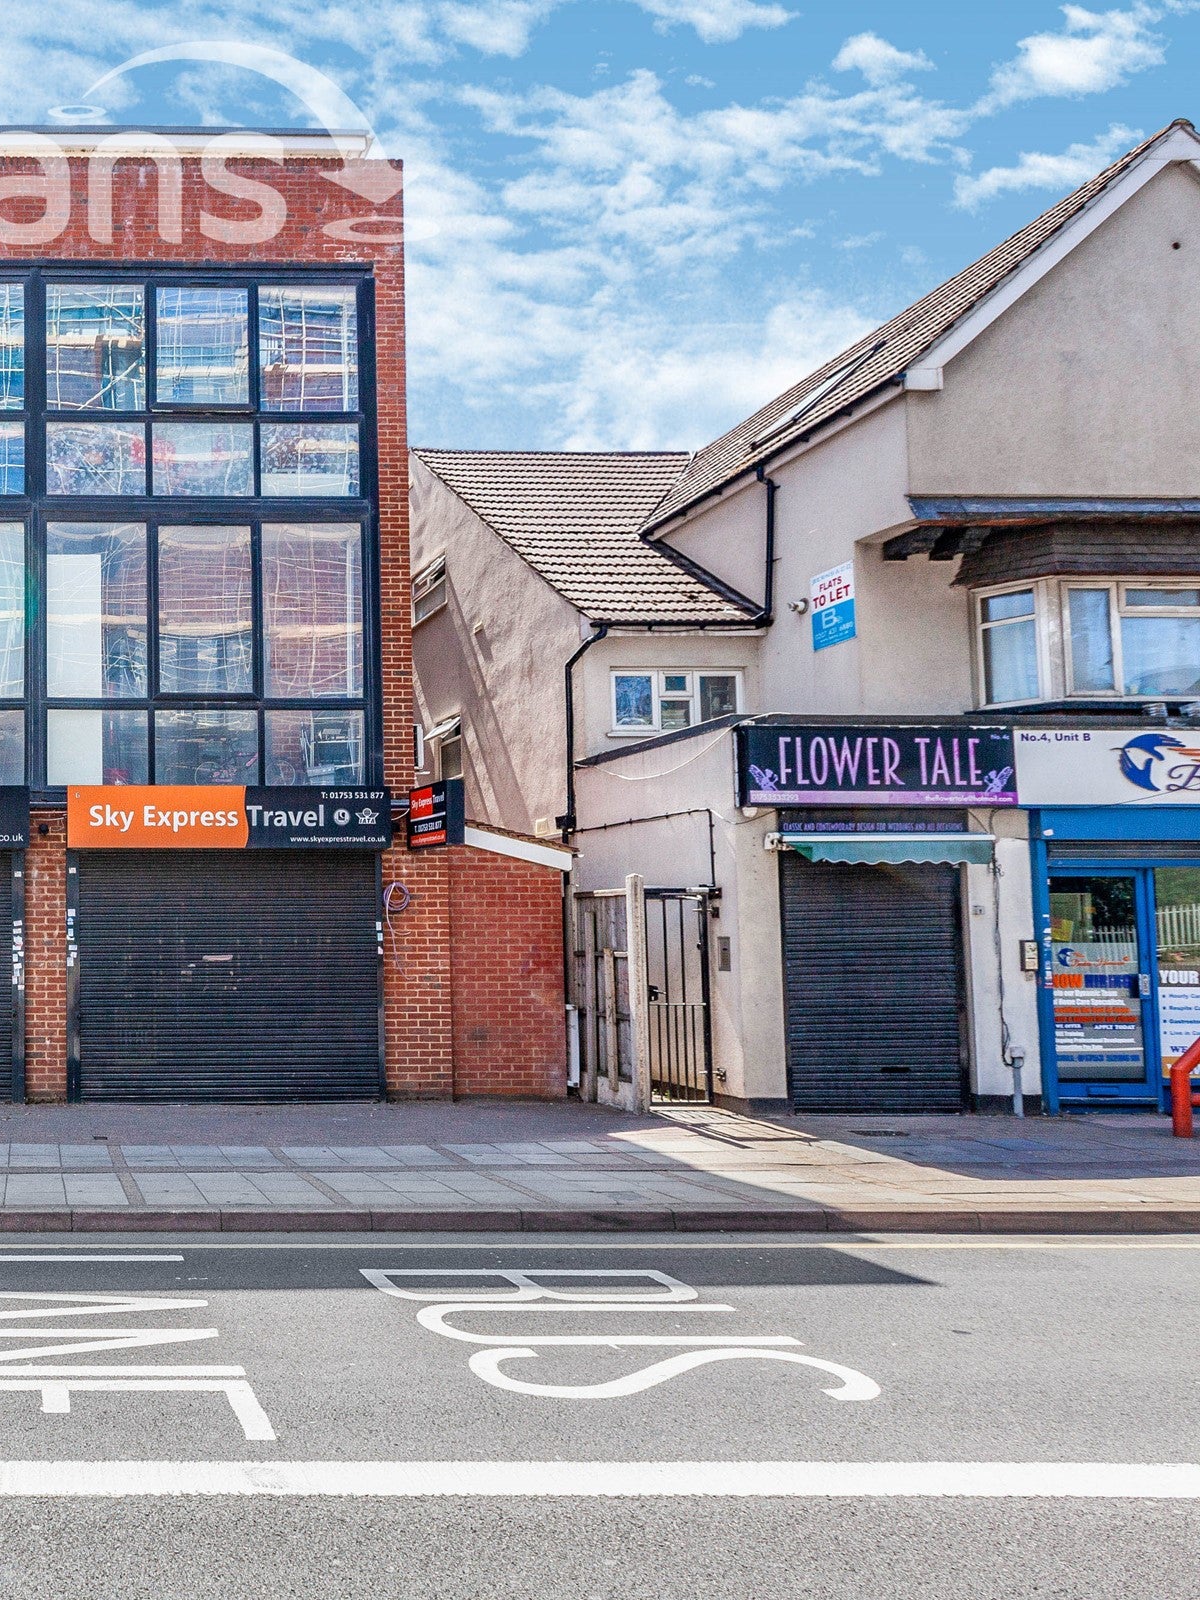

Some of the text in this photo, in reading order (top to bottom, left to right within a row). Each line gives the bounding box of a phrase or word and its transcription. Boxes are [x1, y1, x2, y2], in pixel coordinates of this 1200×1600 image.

[819, 576, 842, 592] FLATS
[813, 584, 850, 609] TO LET
[1020, 733, 1091, 743] No.4, Unit B
[778, 736, 983, 786] FLOWER TALE
[321, 791, 384, 799] T: 01753 531 877
[89, 804, 134, 832] Sky
[143, 804, 239, 833] Express
[246, 804, 325, 828] Travel
[290, 834, 386, 844] www.skyexpresstravel.co.uk
[1159, 970, 1200, 984] YOUR
[360, 1268, 881, 1401] BUS
